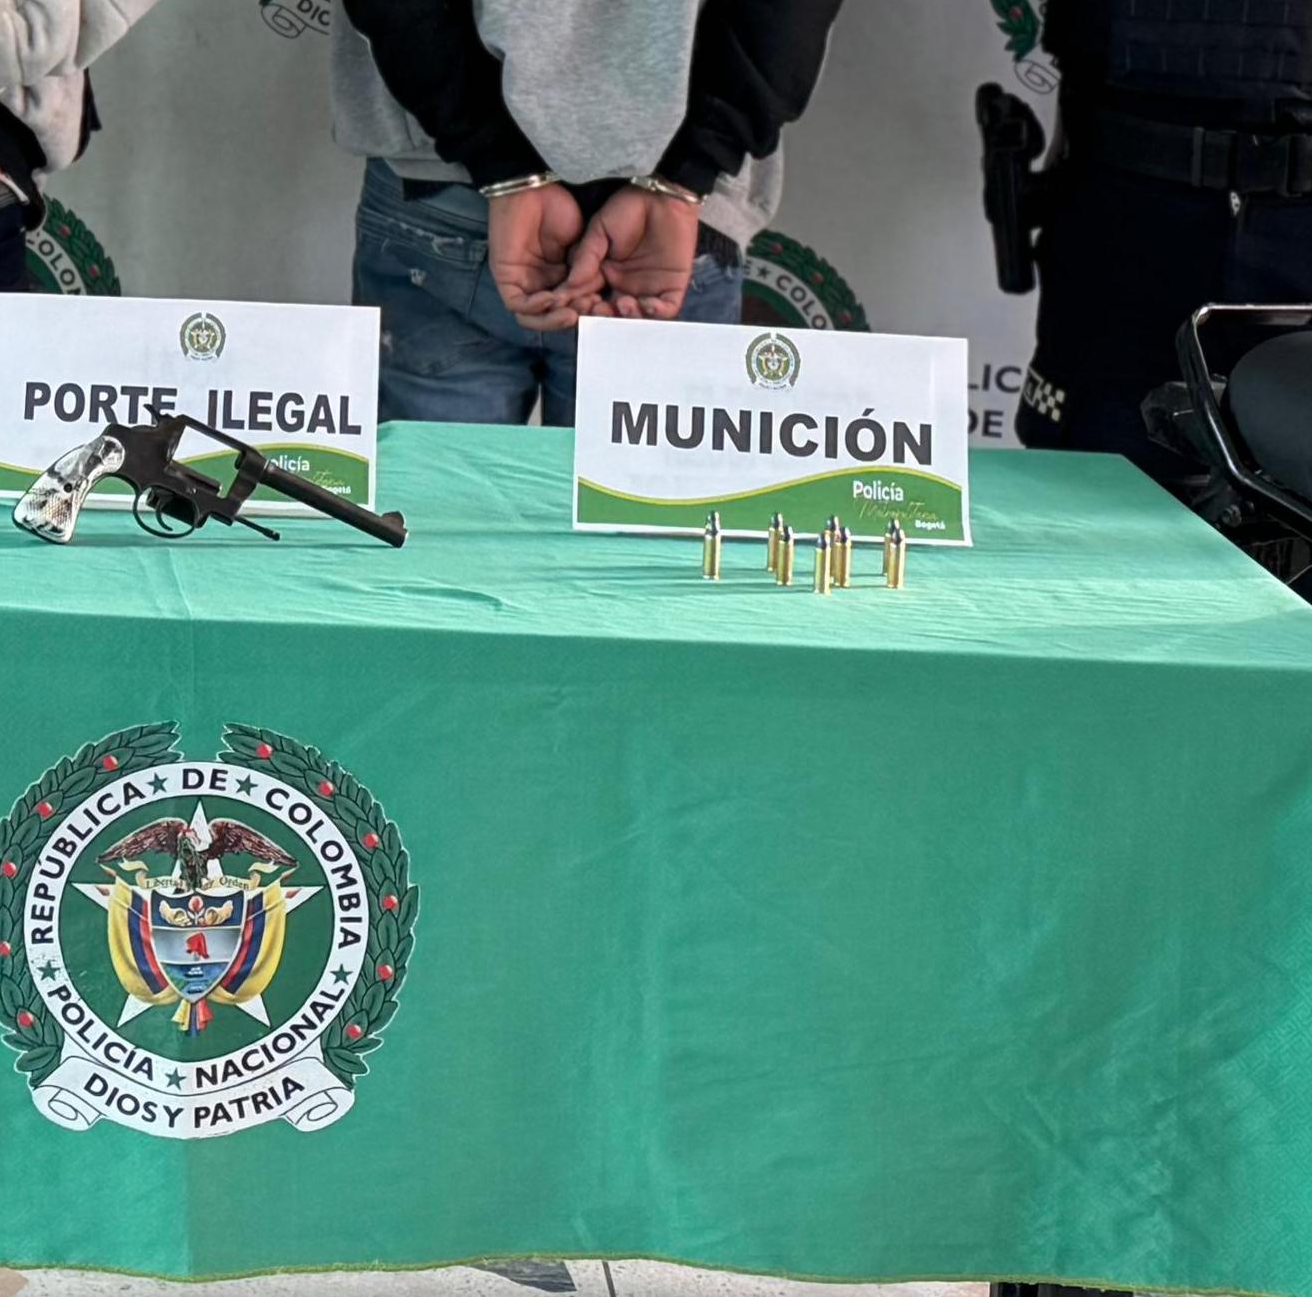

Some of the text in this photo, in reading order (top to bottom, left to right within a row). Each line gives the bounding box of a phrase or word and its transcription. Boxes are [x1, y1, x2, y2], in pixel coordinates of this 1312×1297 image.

[24, 382, 362, 435] PORTE ILEGAL
[612, 401, 931, 465] MUNICIÓN
[853, 480, 904, 502] Policía
[182, 768, 228, 792] DE
[265, 787, 362, 950] COLOMBIA
[48, 983, 345, 1089] POLICÍA NACIONAL
[84, 1072, 306, 1129] DIOS Y PATRIA
